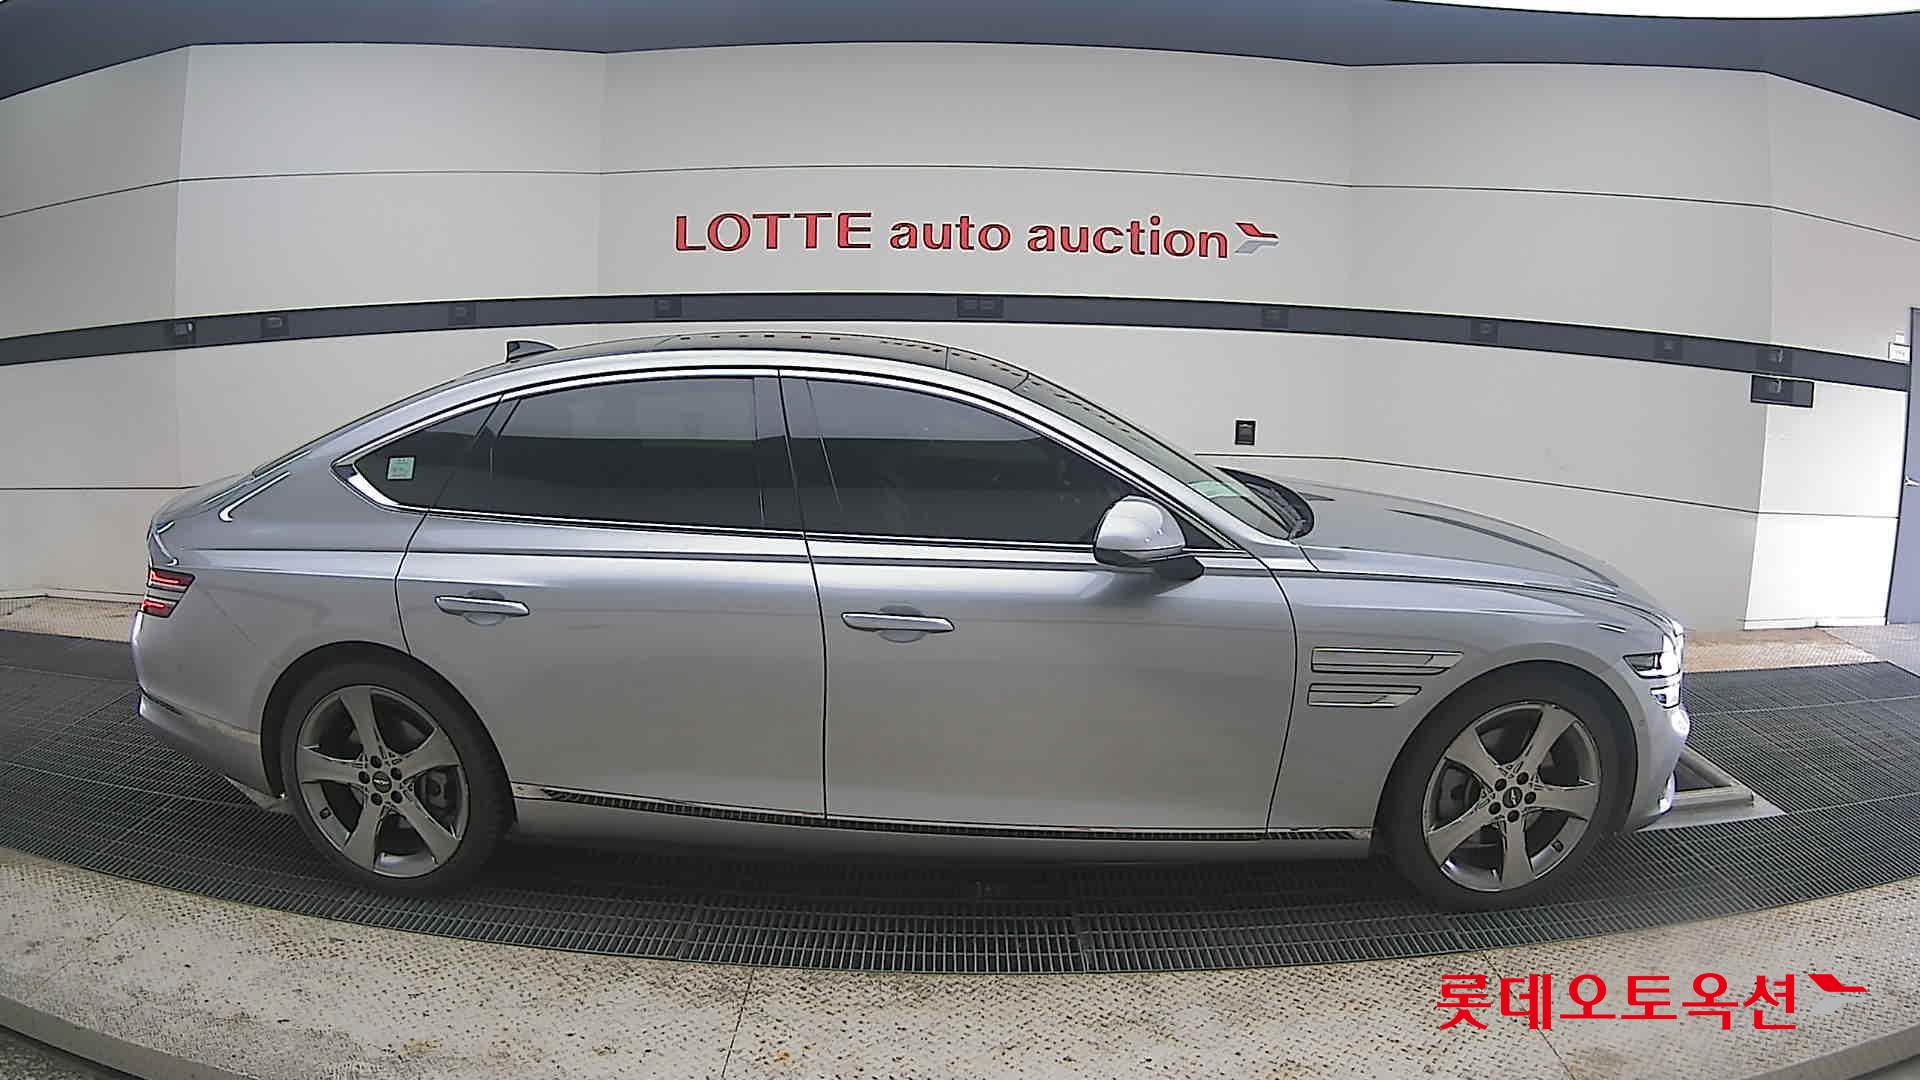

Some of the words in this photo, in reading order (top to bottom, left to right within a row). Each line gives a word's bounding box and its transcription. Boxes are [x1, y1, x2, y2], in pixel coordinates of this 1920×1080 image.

[675, 212, 872, 252] LOTTE
[889, 215, 1011, 252] auto
[1027, 215, 1229, 258] auction
